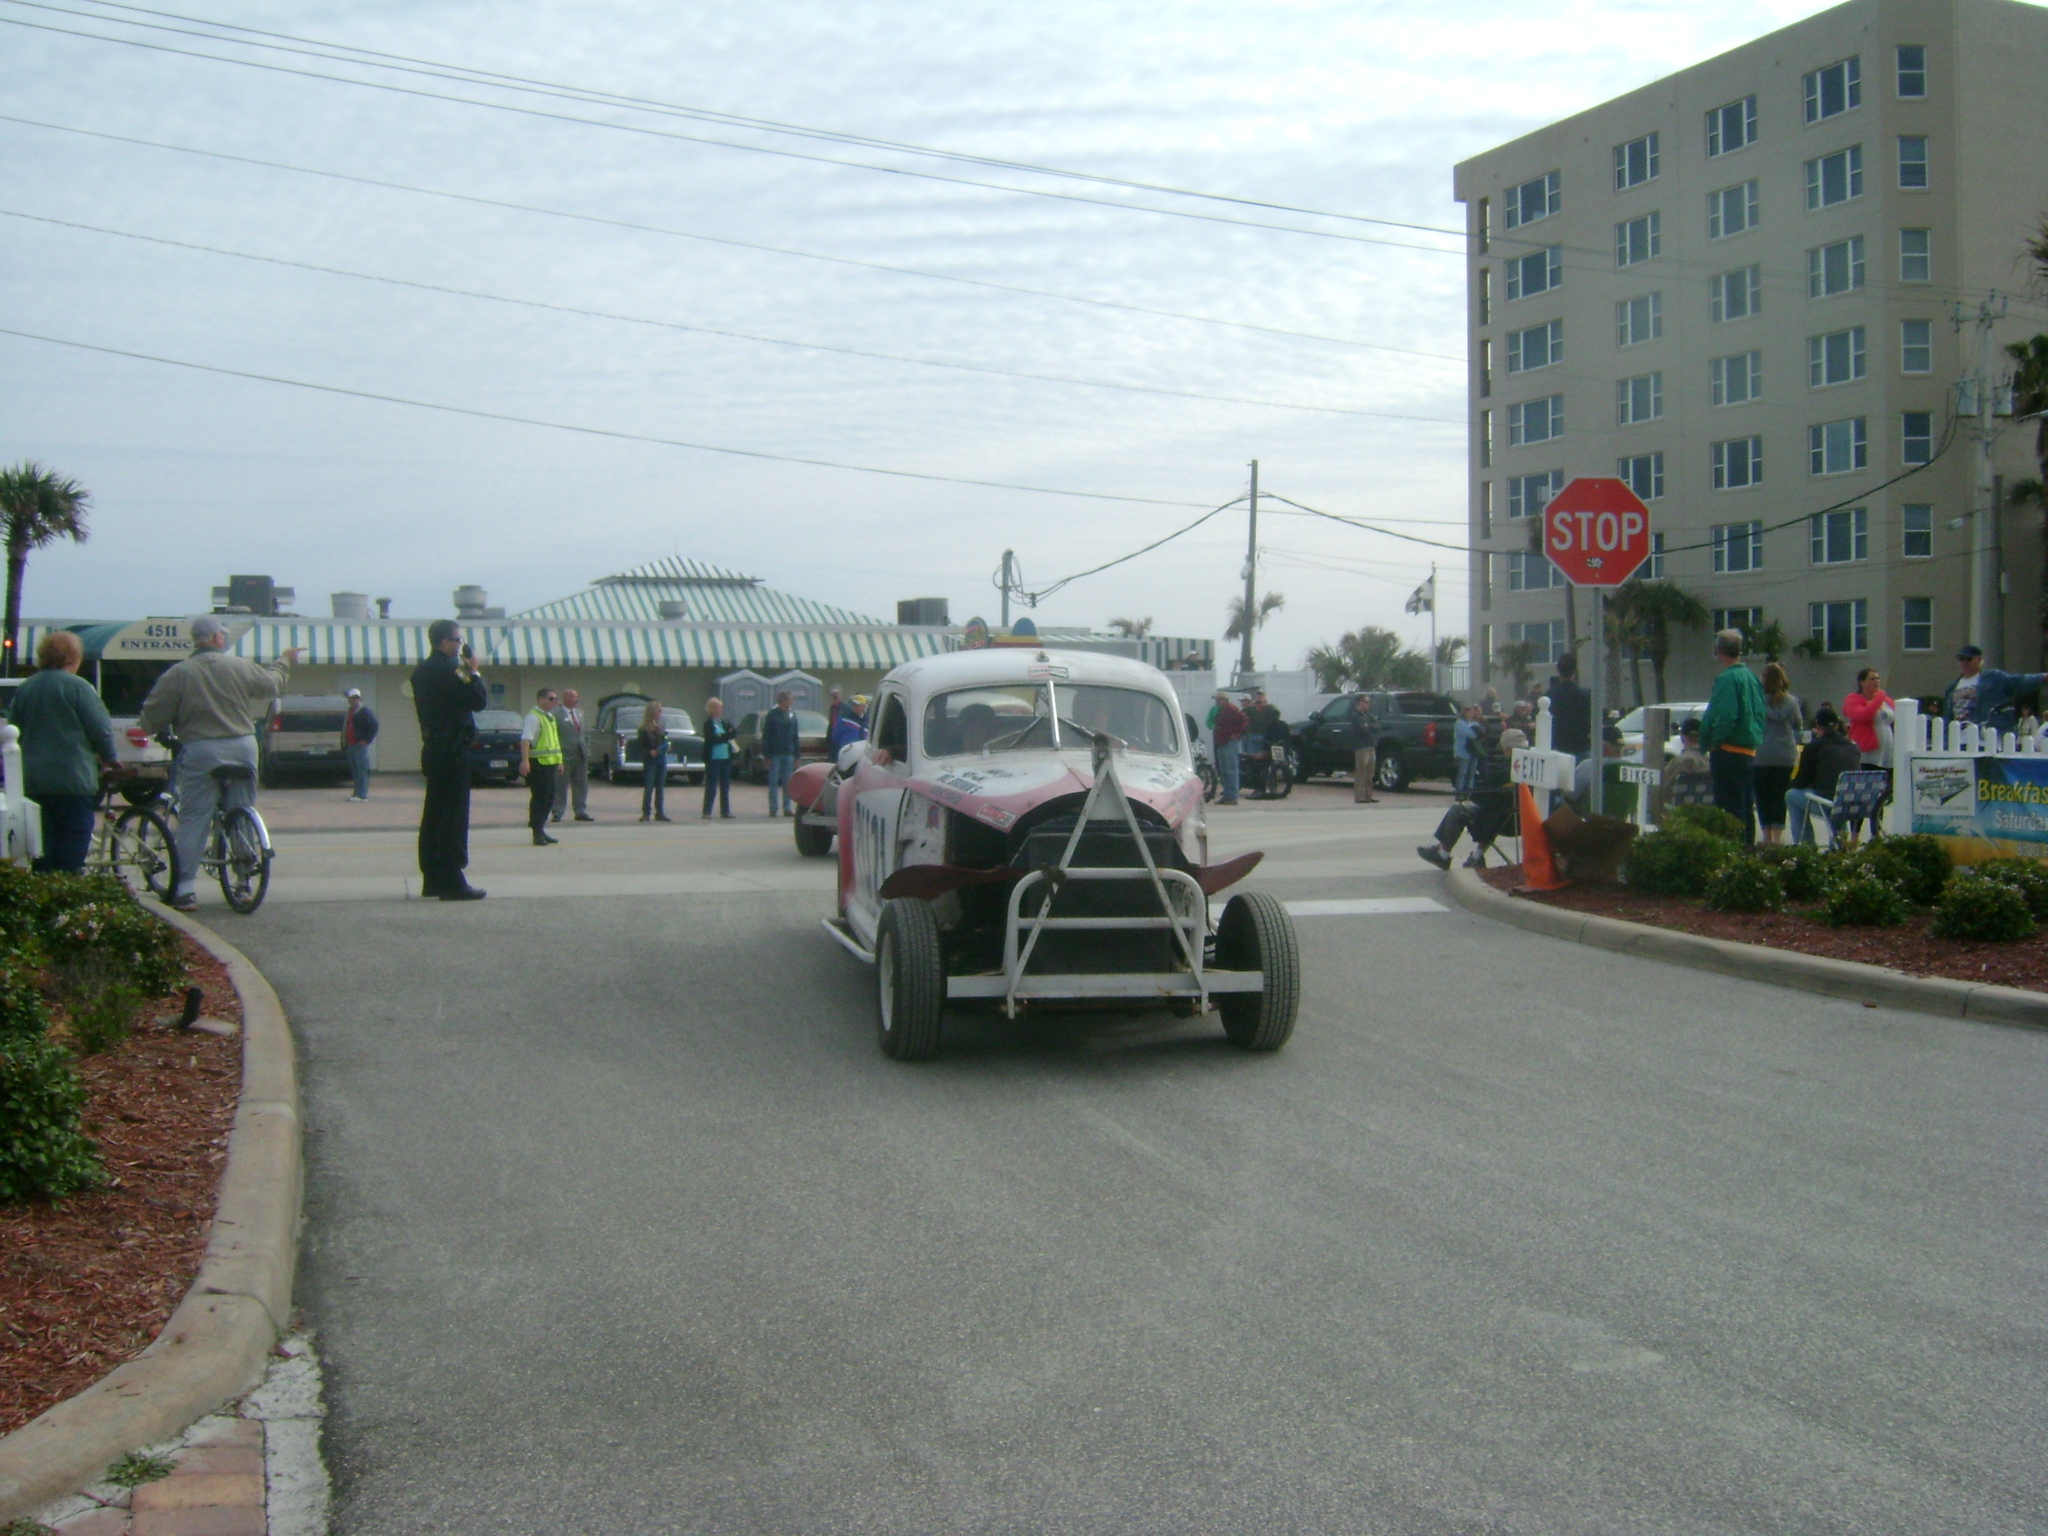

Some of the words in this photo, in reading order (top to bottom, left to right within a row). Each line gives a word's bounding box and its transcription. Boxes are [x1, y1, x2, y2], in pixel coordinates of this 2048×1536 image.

[1551, 511, 1643, 551] STOP
[144, 624, 178, 637] 4511
[121, 640, 193, 649] ENTRANC
[1522, 756, 1546, 783] EXIT
[1621, 765, 1655, 785] BIKES
